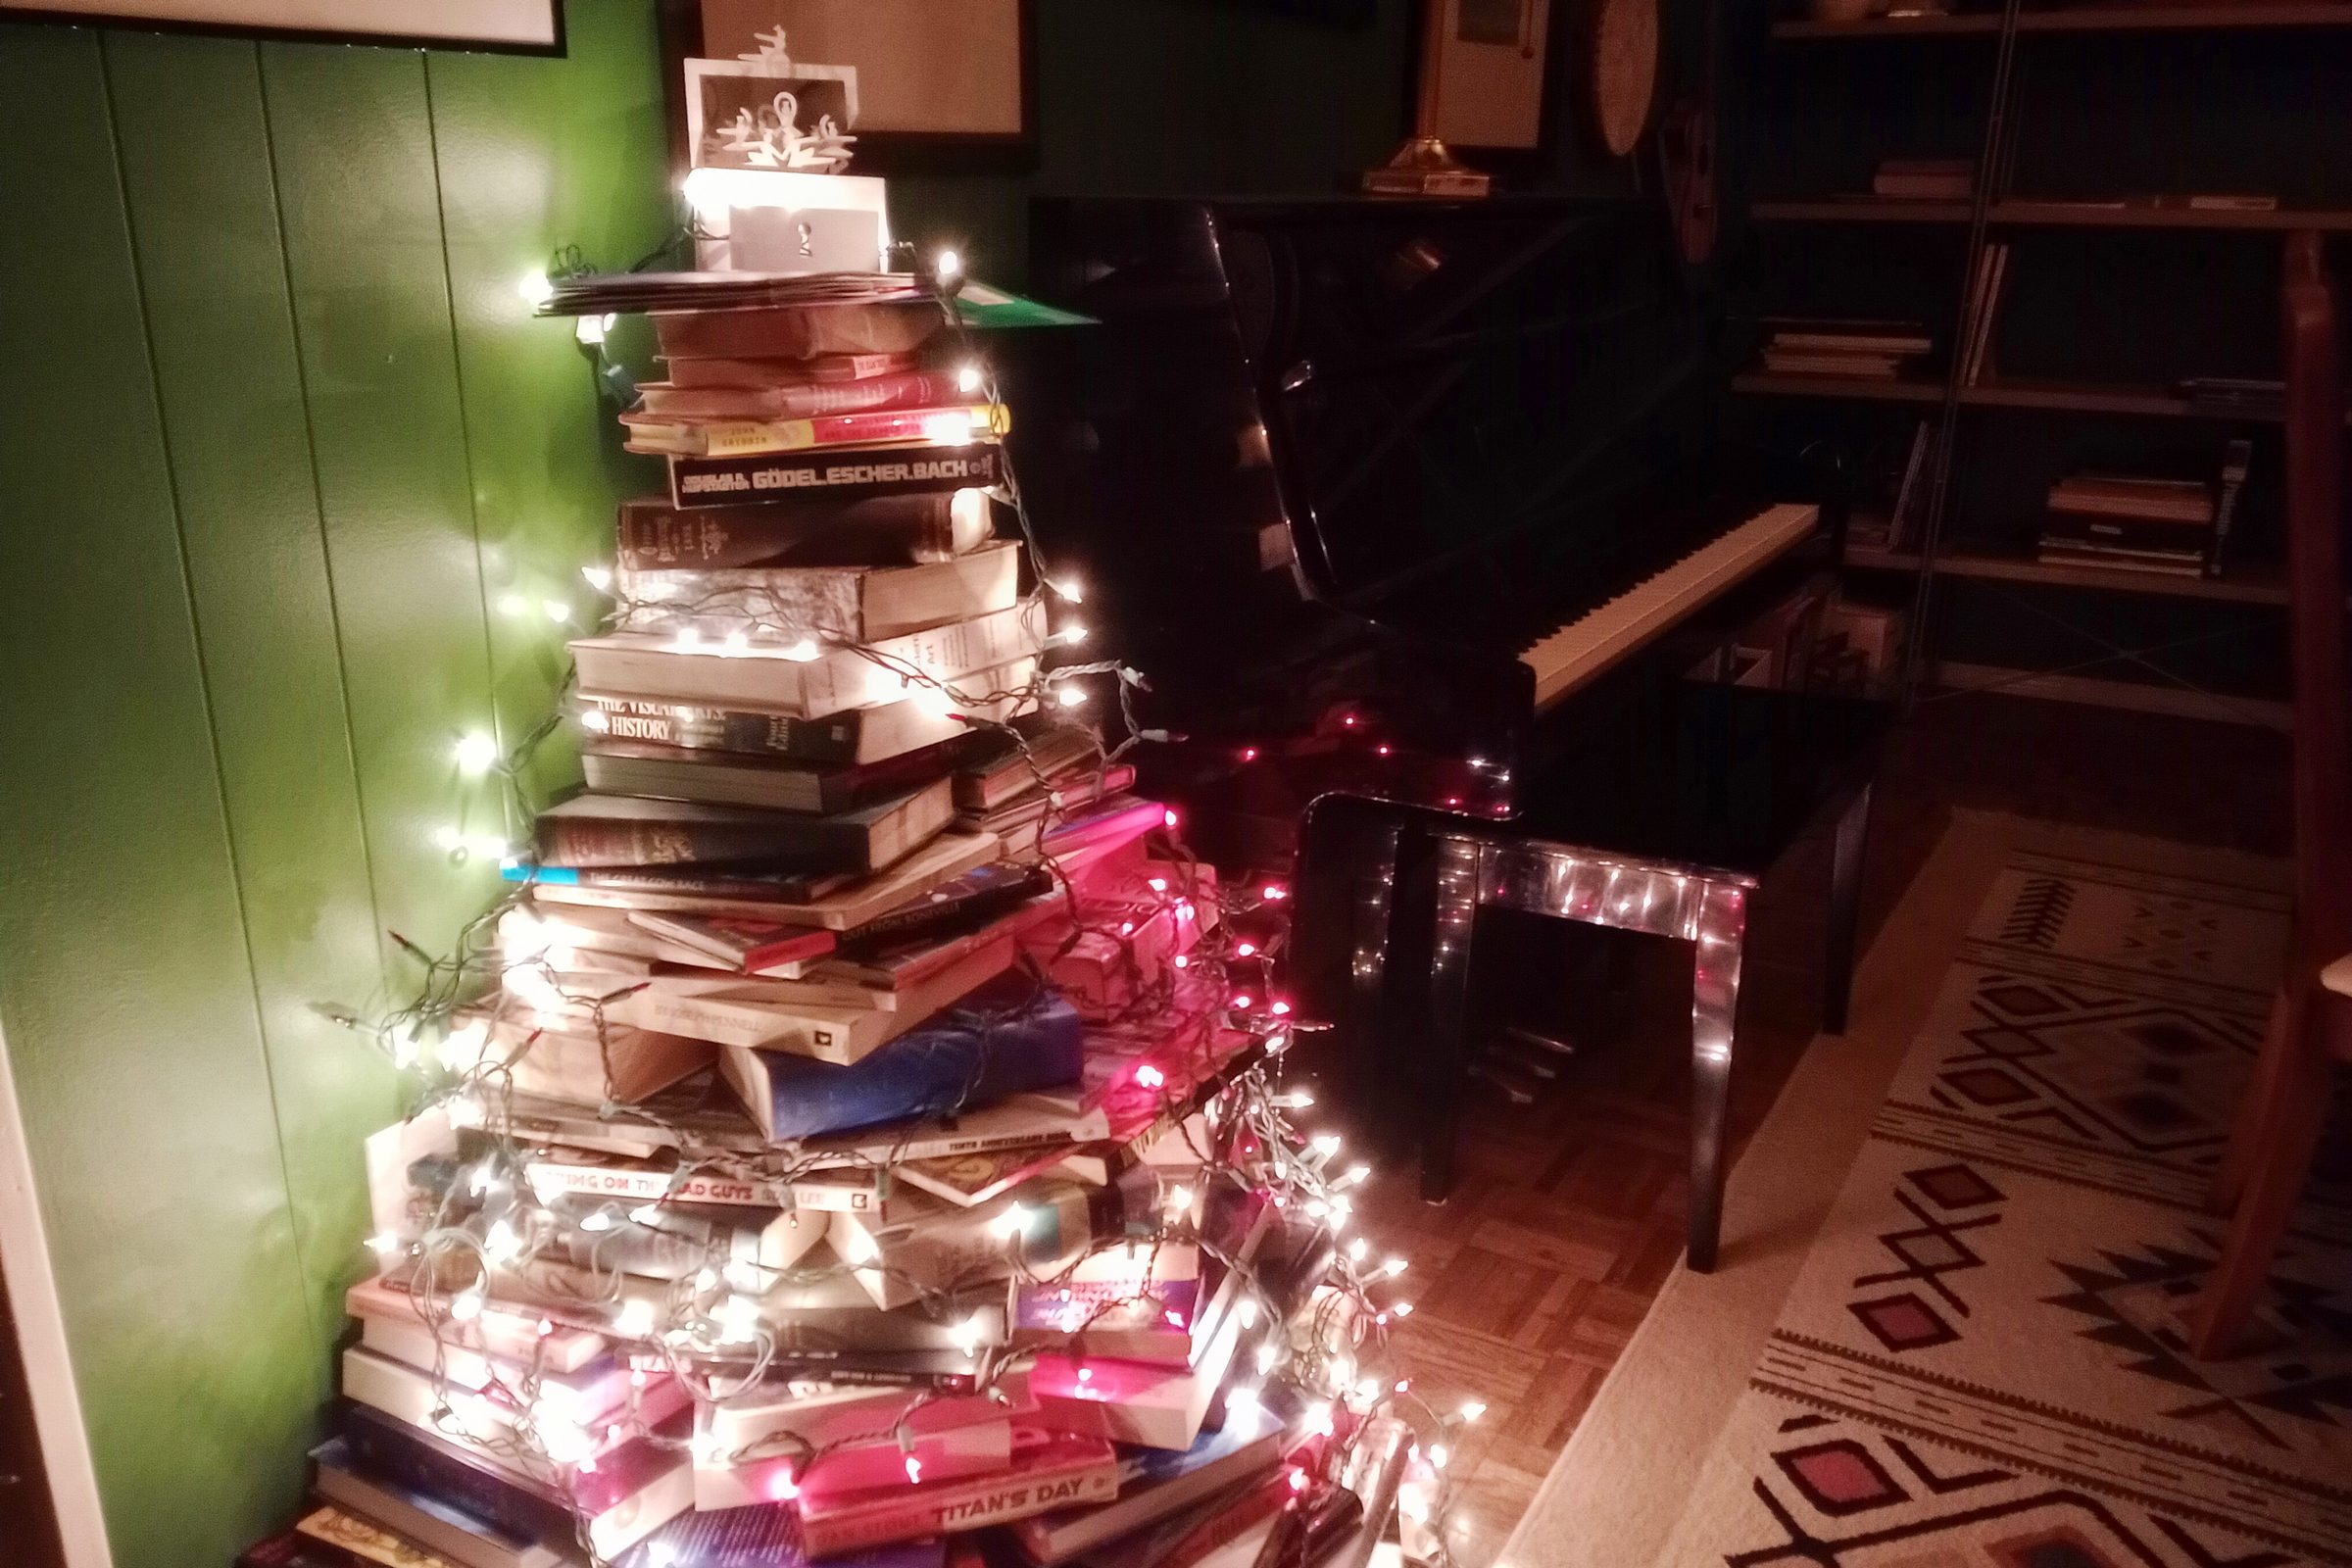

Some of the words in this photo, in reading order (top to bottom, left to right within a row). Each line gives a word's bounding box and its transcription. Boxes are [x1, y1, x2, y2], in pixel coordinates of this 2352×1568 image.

[611, 715, 673, 740] HISTORY
[604, 1176, 629, 1190] ON
[932, 1489, 1029, 1525] TITAN'S
[1035, 1476, 1085, 1503] DAY
